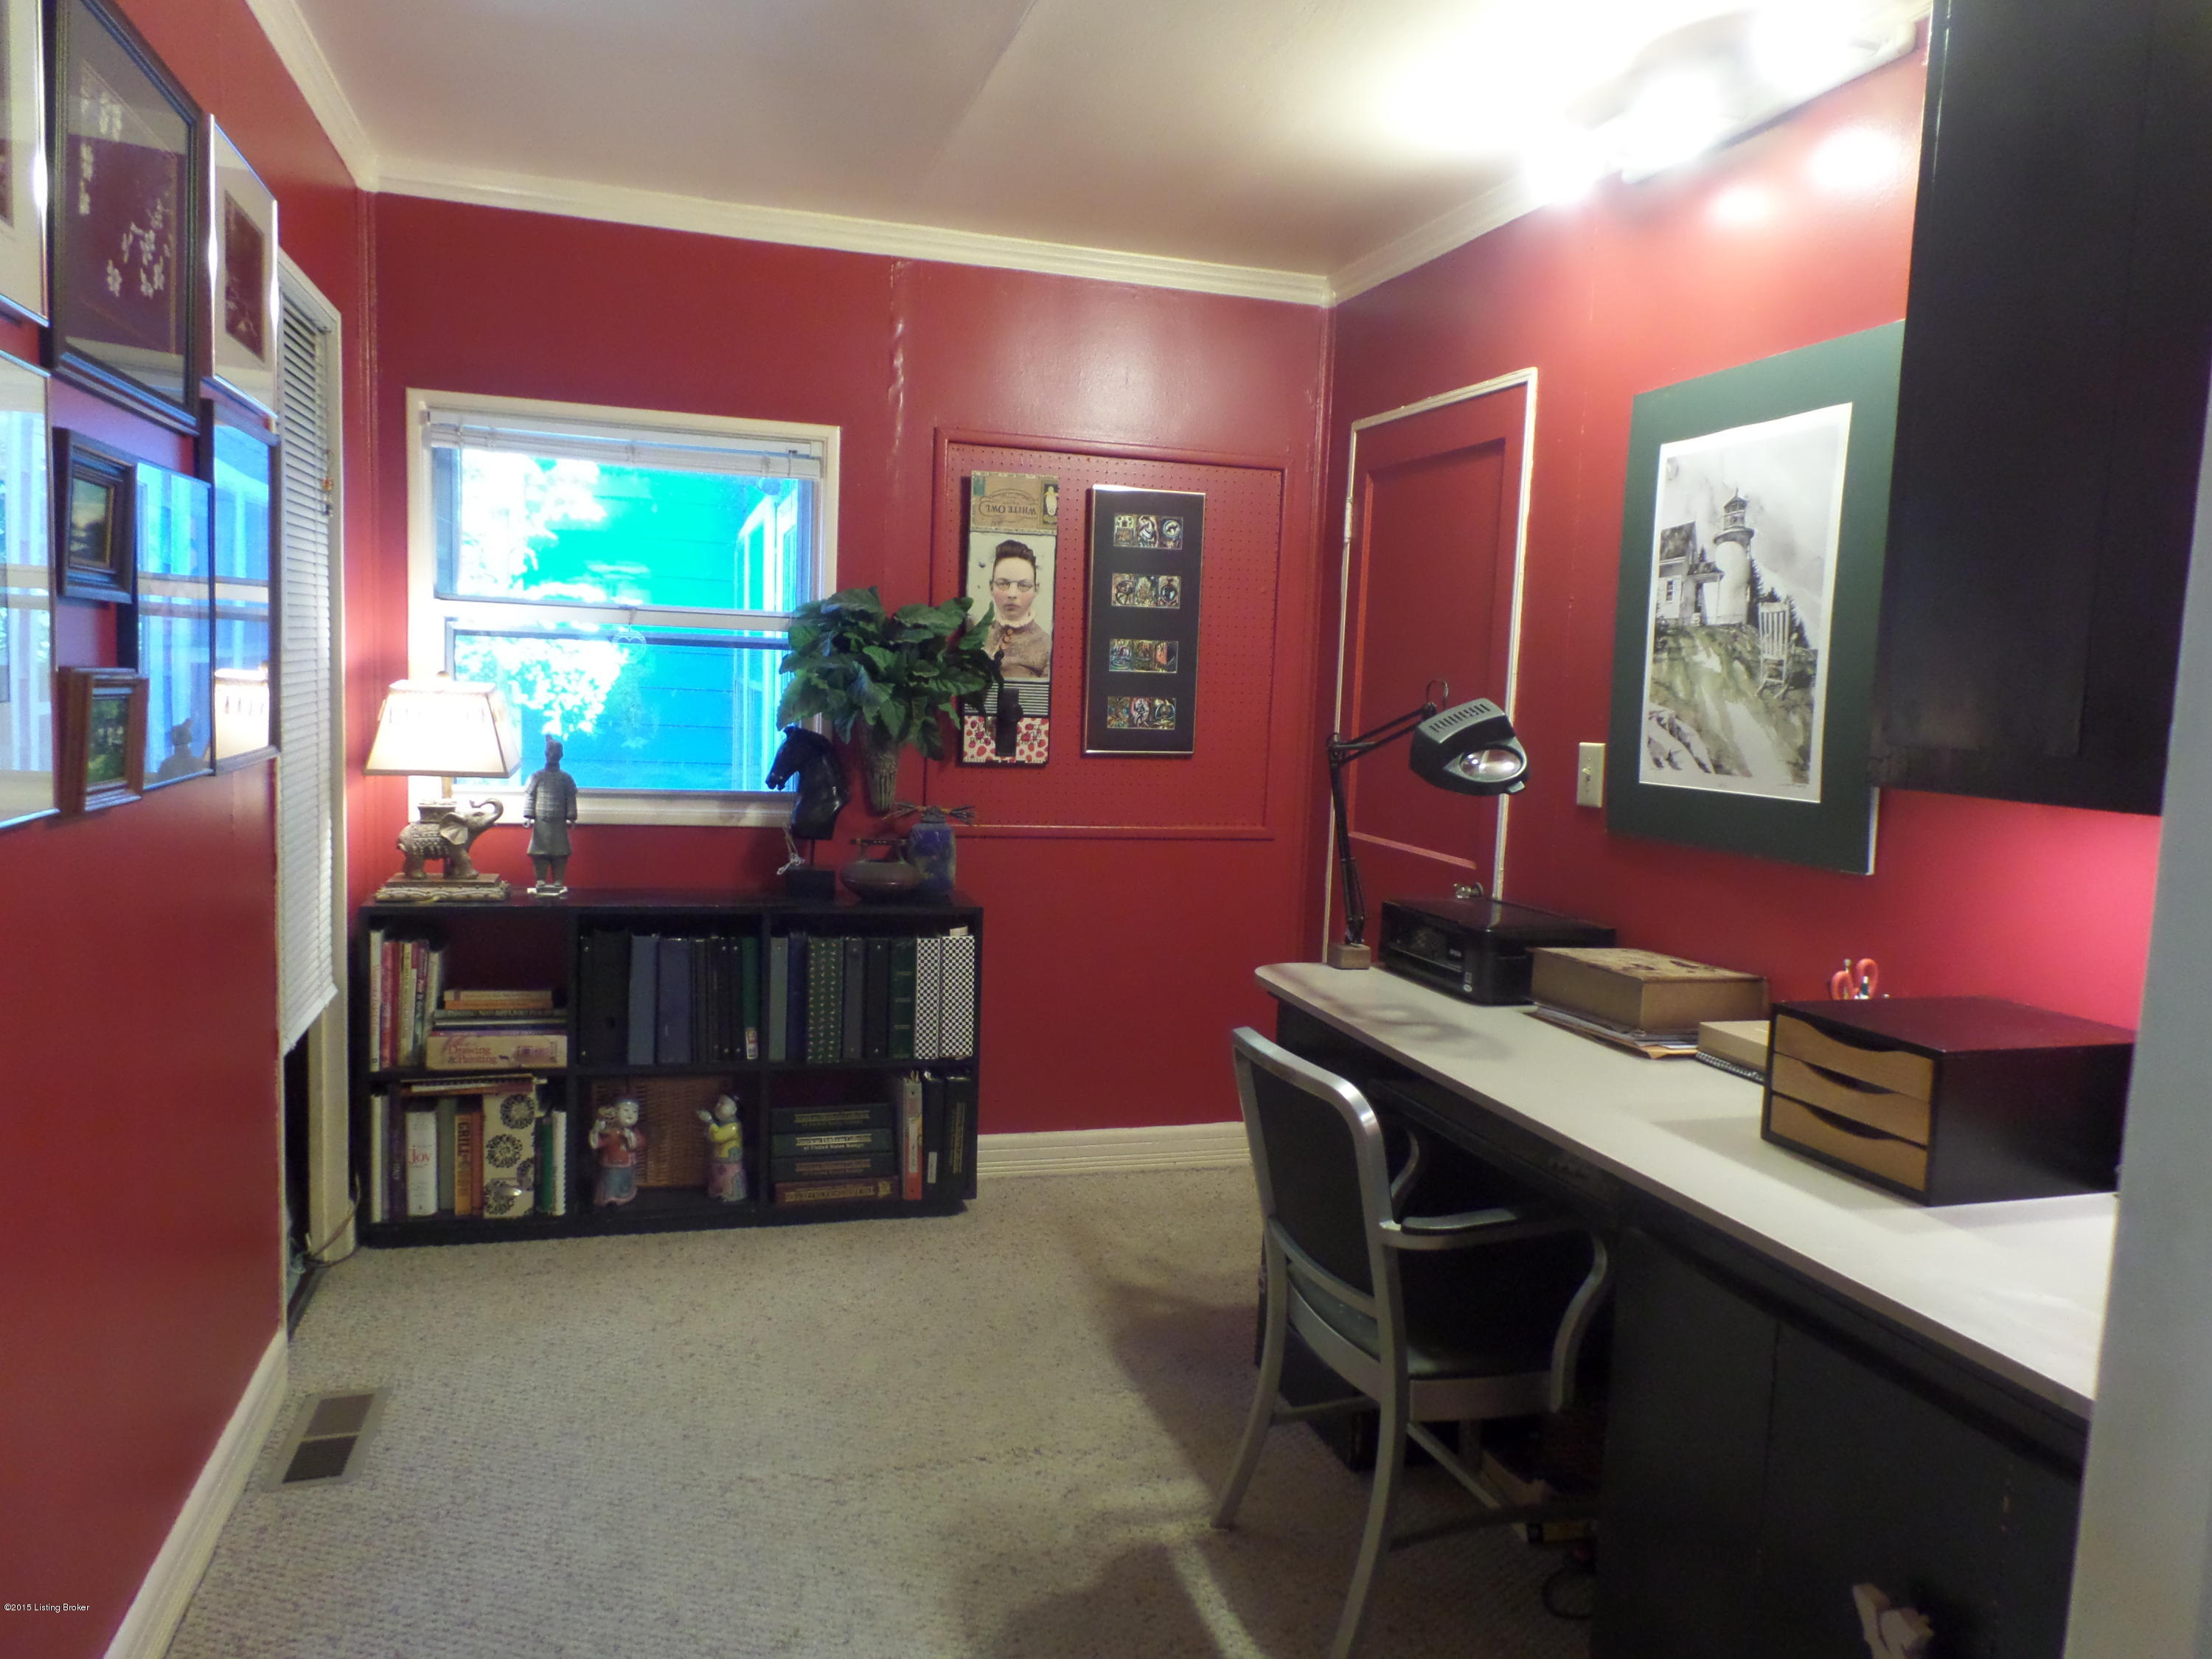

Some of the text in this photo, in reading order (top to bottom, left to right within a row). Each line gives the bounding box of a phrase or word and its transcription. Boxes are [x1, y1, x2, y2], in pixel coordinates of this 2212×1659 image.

[987, 504, 1036, 515] WHITE OWL
[409, 1149, 432, 1166] Joy
